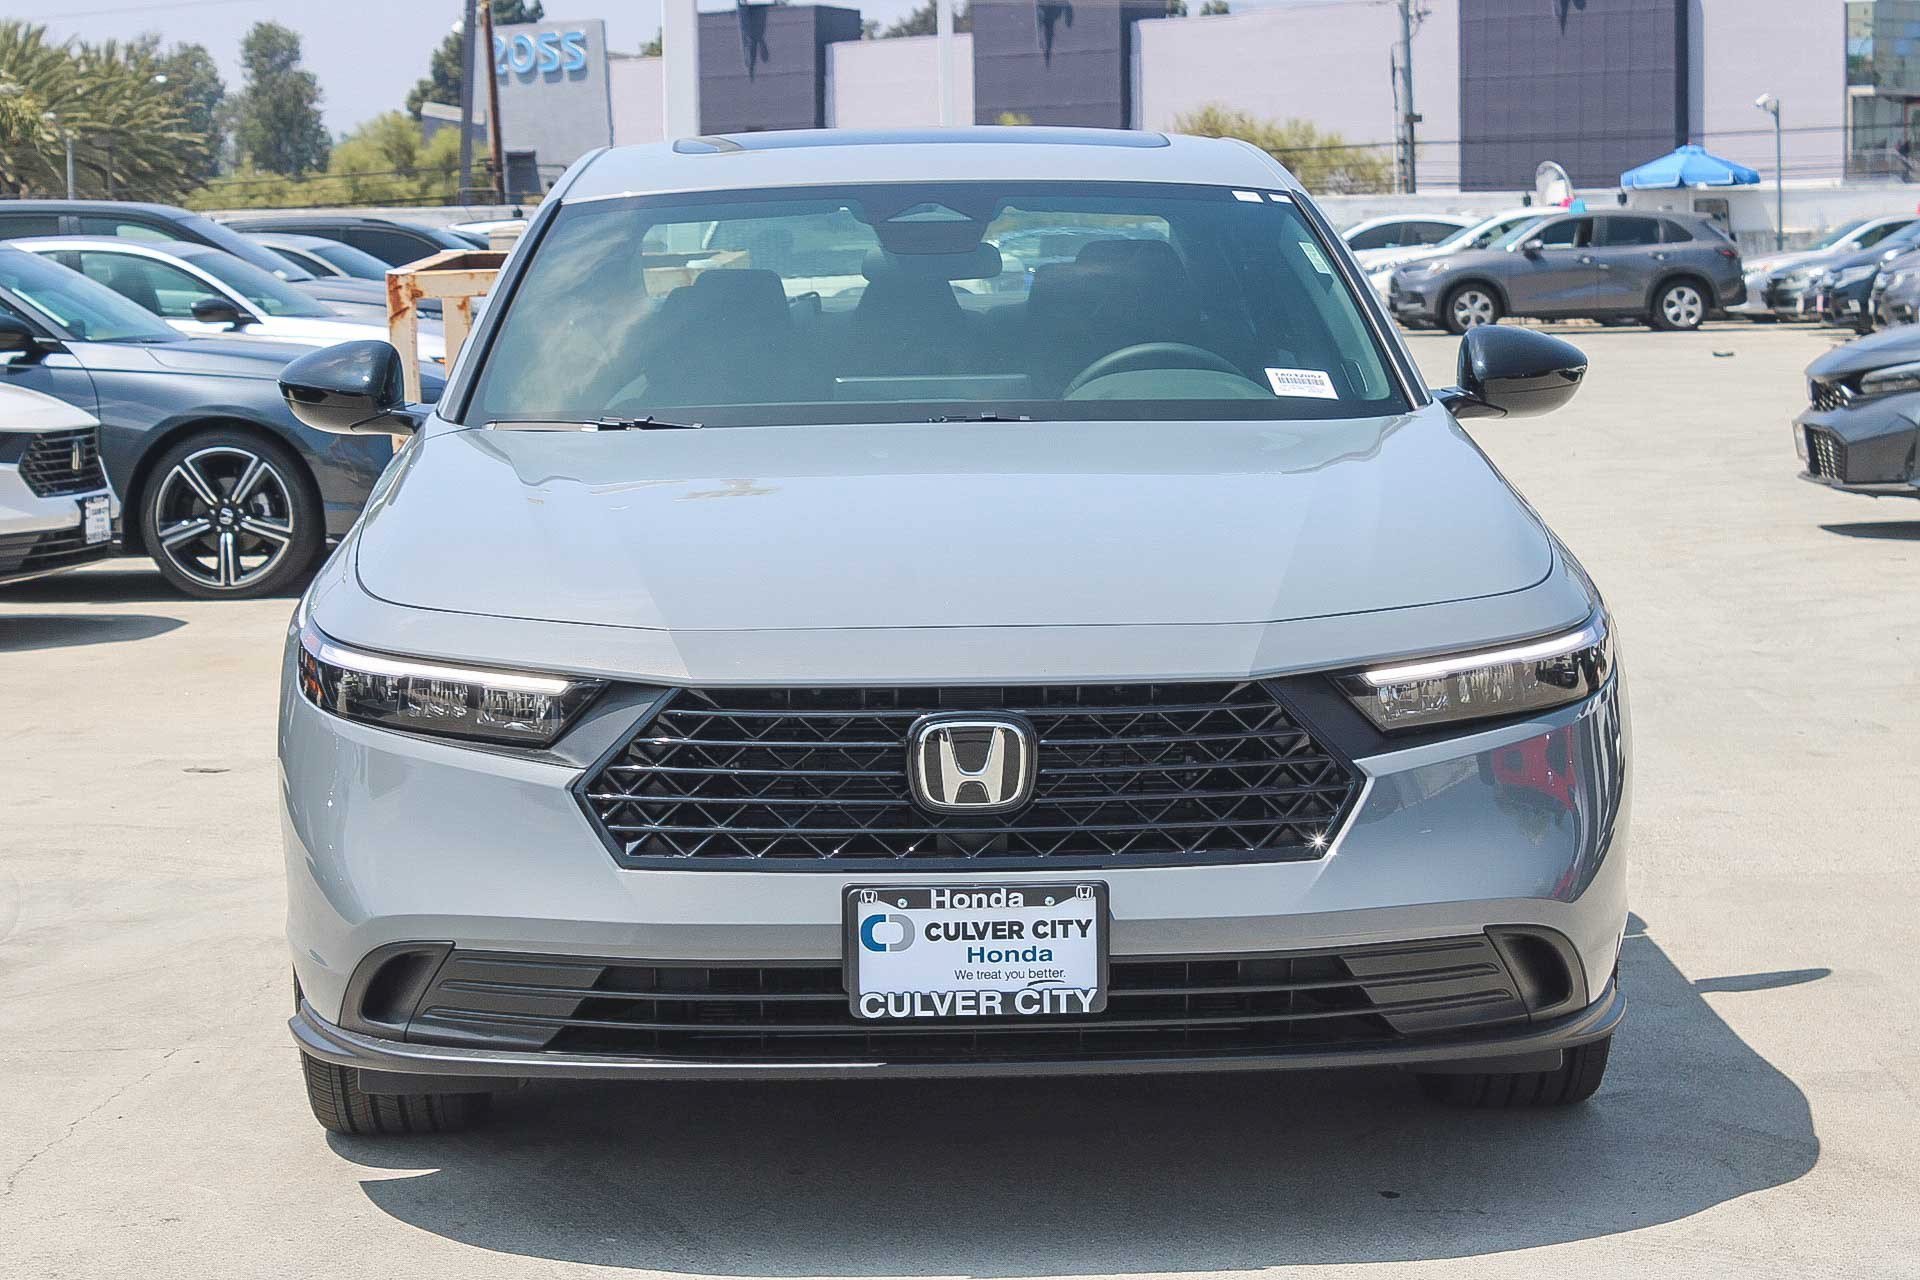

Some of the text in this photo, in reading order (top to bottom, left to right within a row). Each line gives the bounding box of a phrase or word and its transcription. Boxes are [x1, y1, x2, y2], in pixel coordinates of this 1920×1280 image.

[930, 888, 1024, 909] Honda
[924, 918, 1093, 942] CULVER CITY
[967, 945, 1053, 963] Honda
[954, 968, 1066, 982] We treat you better.
[859, 988, 1098, 1019] CULVER CITY
